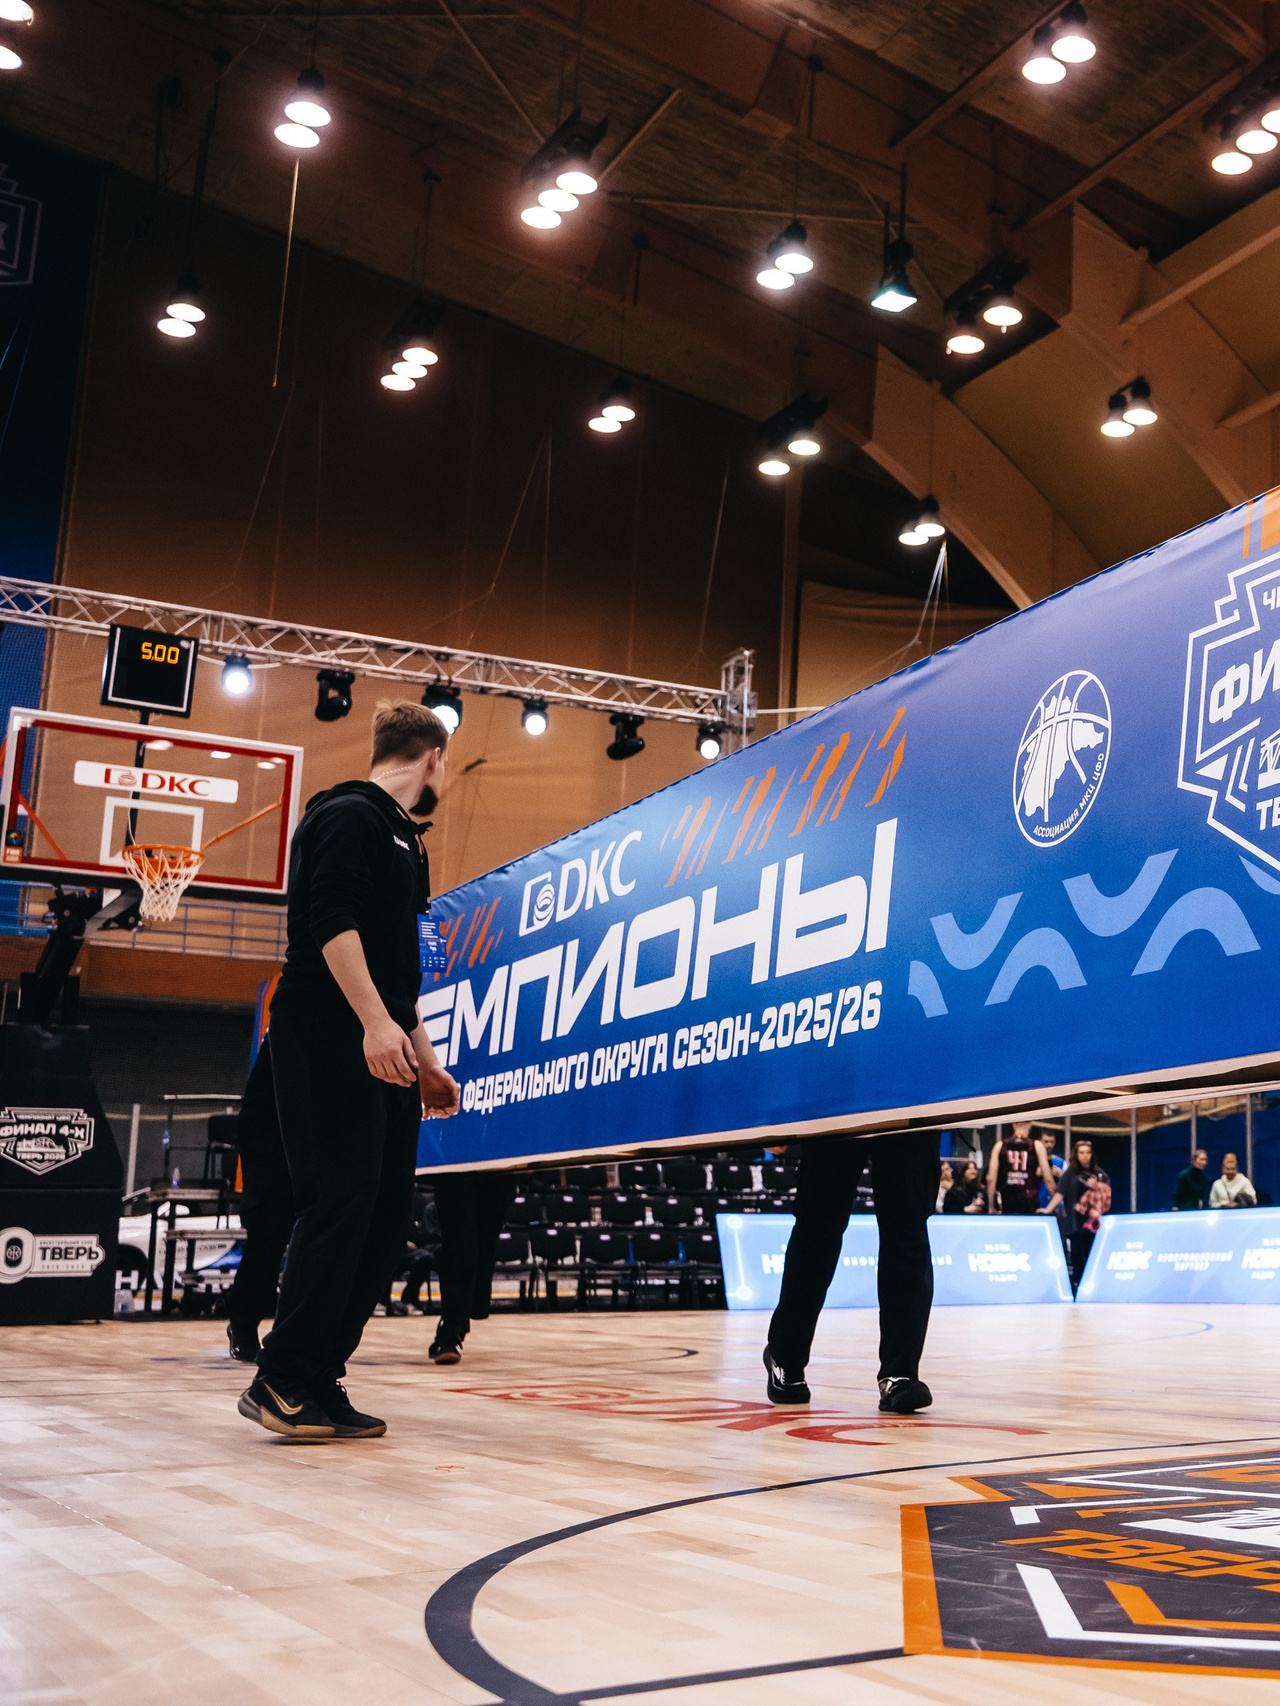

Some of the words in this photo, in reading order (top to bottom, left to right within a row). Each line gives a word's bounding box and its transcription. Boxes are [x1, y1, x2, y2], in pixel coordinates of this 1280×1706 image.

[141, 773, 210, 796] DKC
[1032, 809, 1080, 838] АССОЦИАЦИЯ
[1079, 784, 1096, 810] МКЦ
[1092, 752, 1105, 781] ЦФО
[555, 830, 642, 923] DKC
[414, 817, 898, 1068] ЕМПИОНЫ
[462, 1049, 587, 1114] ФЕДЕРАЛЬНОГО
[591, 1032, 668, 1086] ОКРУГА
[672, 980, 883, 1070] СЕЗОН-2025/26
[0, 1123, 56, 1137] ФИНАЛ
[59, 1124, 85, 1139] 4-Х
[1007, 1150, 1028, 1171] 41
[39, 1246, 99, 1260] ТВЕРЬ
